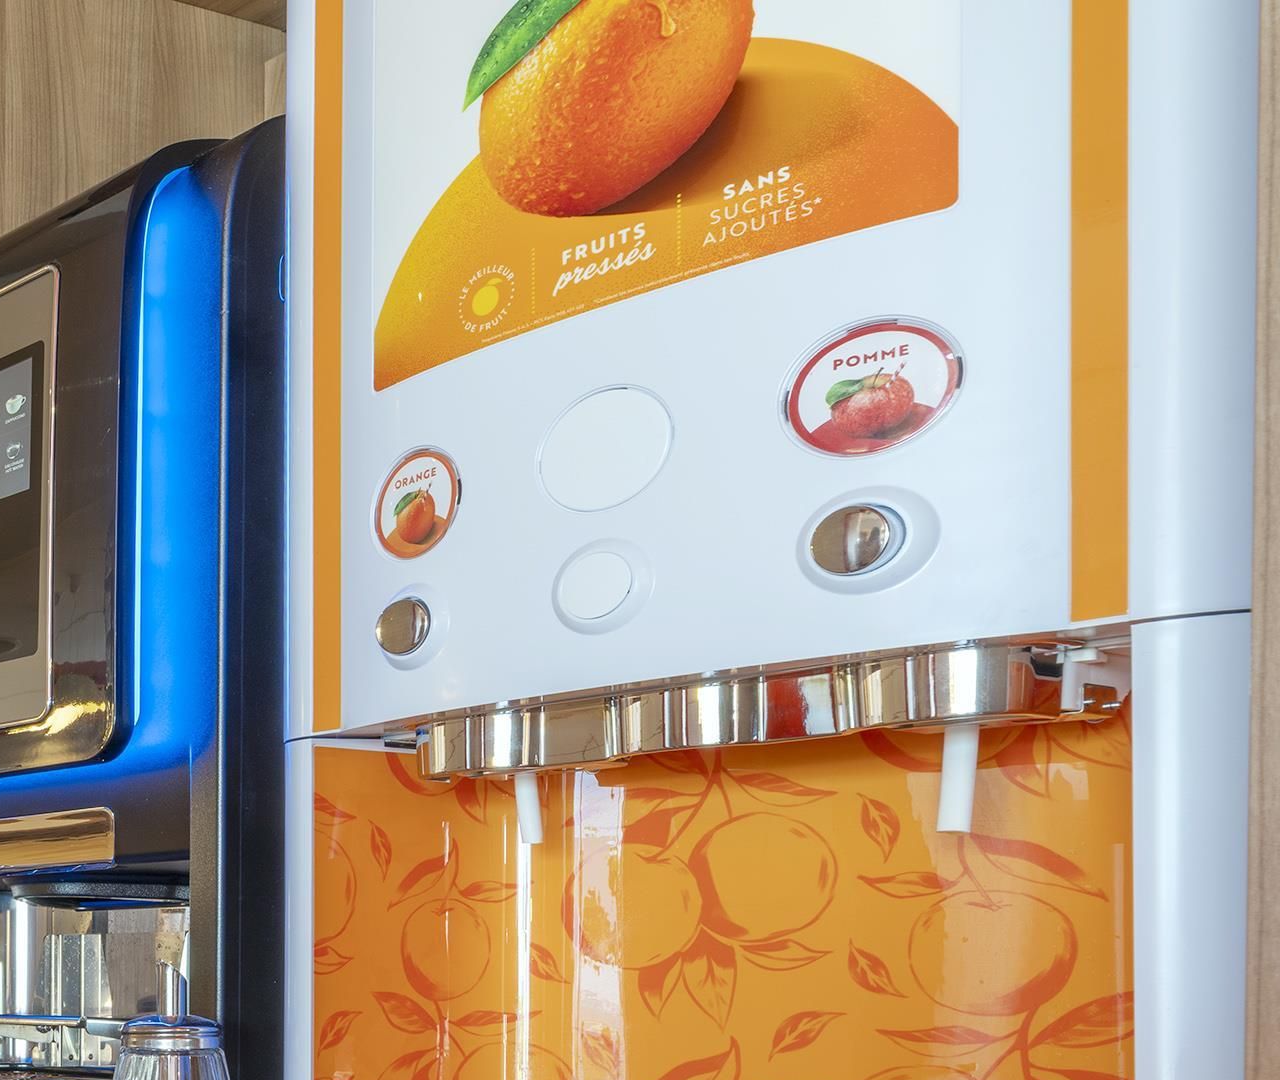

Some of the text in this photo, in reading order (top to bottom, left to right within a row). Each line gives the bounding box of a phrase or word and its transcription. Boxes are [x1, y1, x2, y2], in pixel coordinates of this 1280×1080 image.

[723, 166, 791, 200] SANS
[710, 183, 805, 225] SUCRES
[561, 222, 646, 265] FRUITS
[459, 264, 515, 300] LE MEILLEUR
[552, 240, 657, 297] pressés
[464, 322, 477, 333] DE
[479, 308, 508, 332] FRUIT
[832, 344, 910, 371] POMME
[394, 467, 437, 490] ORANGE
